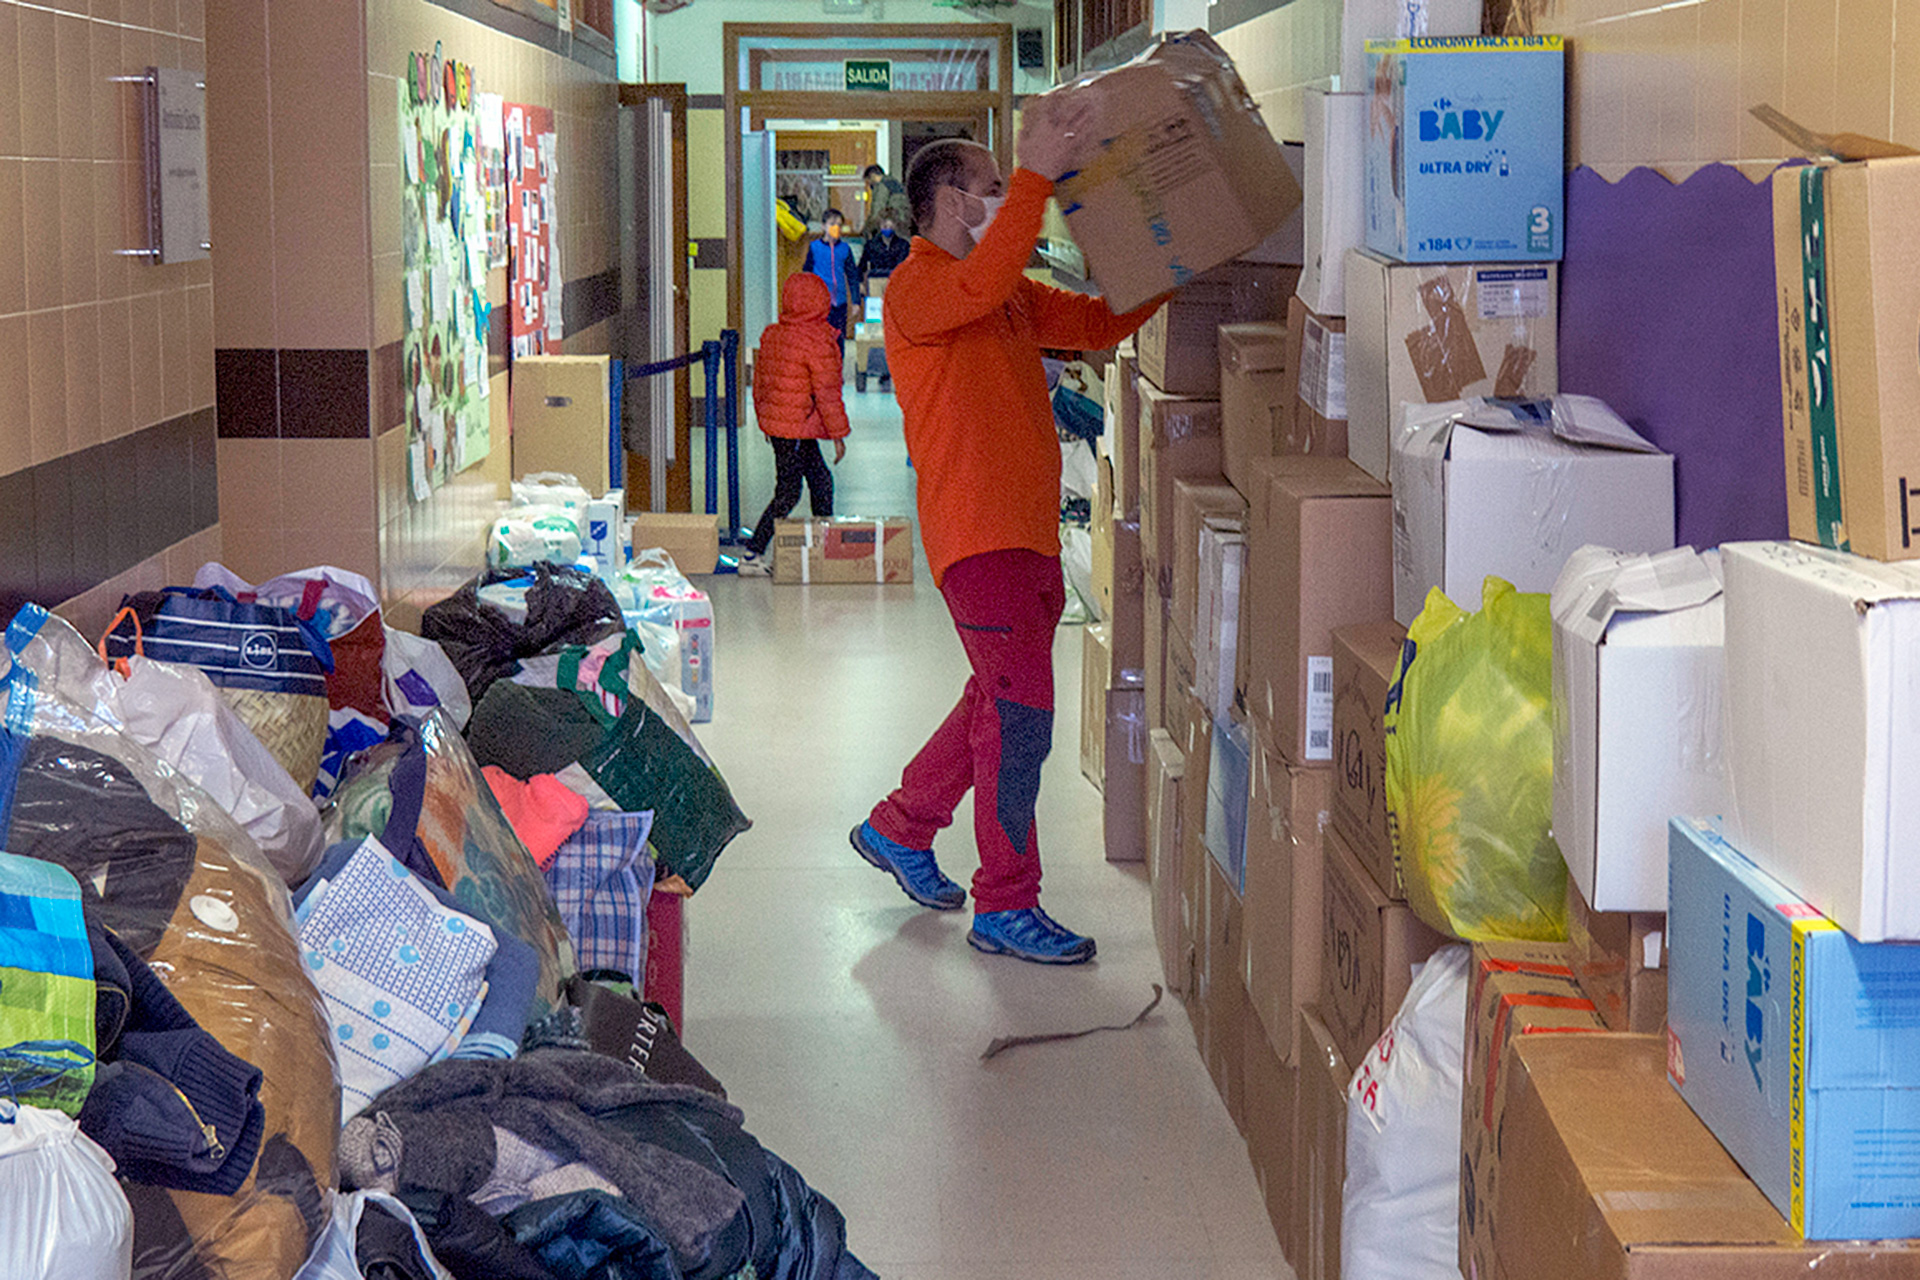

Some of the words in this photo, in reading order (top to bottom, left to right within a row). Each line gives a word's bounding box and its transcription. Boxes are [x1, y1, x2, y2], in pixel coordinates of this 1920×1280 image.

[1410, 36, 1474, 48] ECONOMY
[1476, 36, 1509, 48] PACK
[1522, 36, 1544, 47] 184
[847, 68, 889, 84] SALIDA
[1419, 109, 1504, 142] BABY
[1419, 161, 1462, 175] ULTRA
[1465, 160, 1493, 174] DRY
[1530, 206, 1550, 234] 3
[1722, 892, 1731, 971] ULTRA
[1722, 979, 1730, 1031] DRY
[1744, 911, 1765, 1094] BABY
[1792, 940, 1801, 1061] ECONOMY
[1791, 1062, 1801, 1125] PACK
